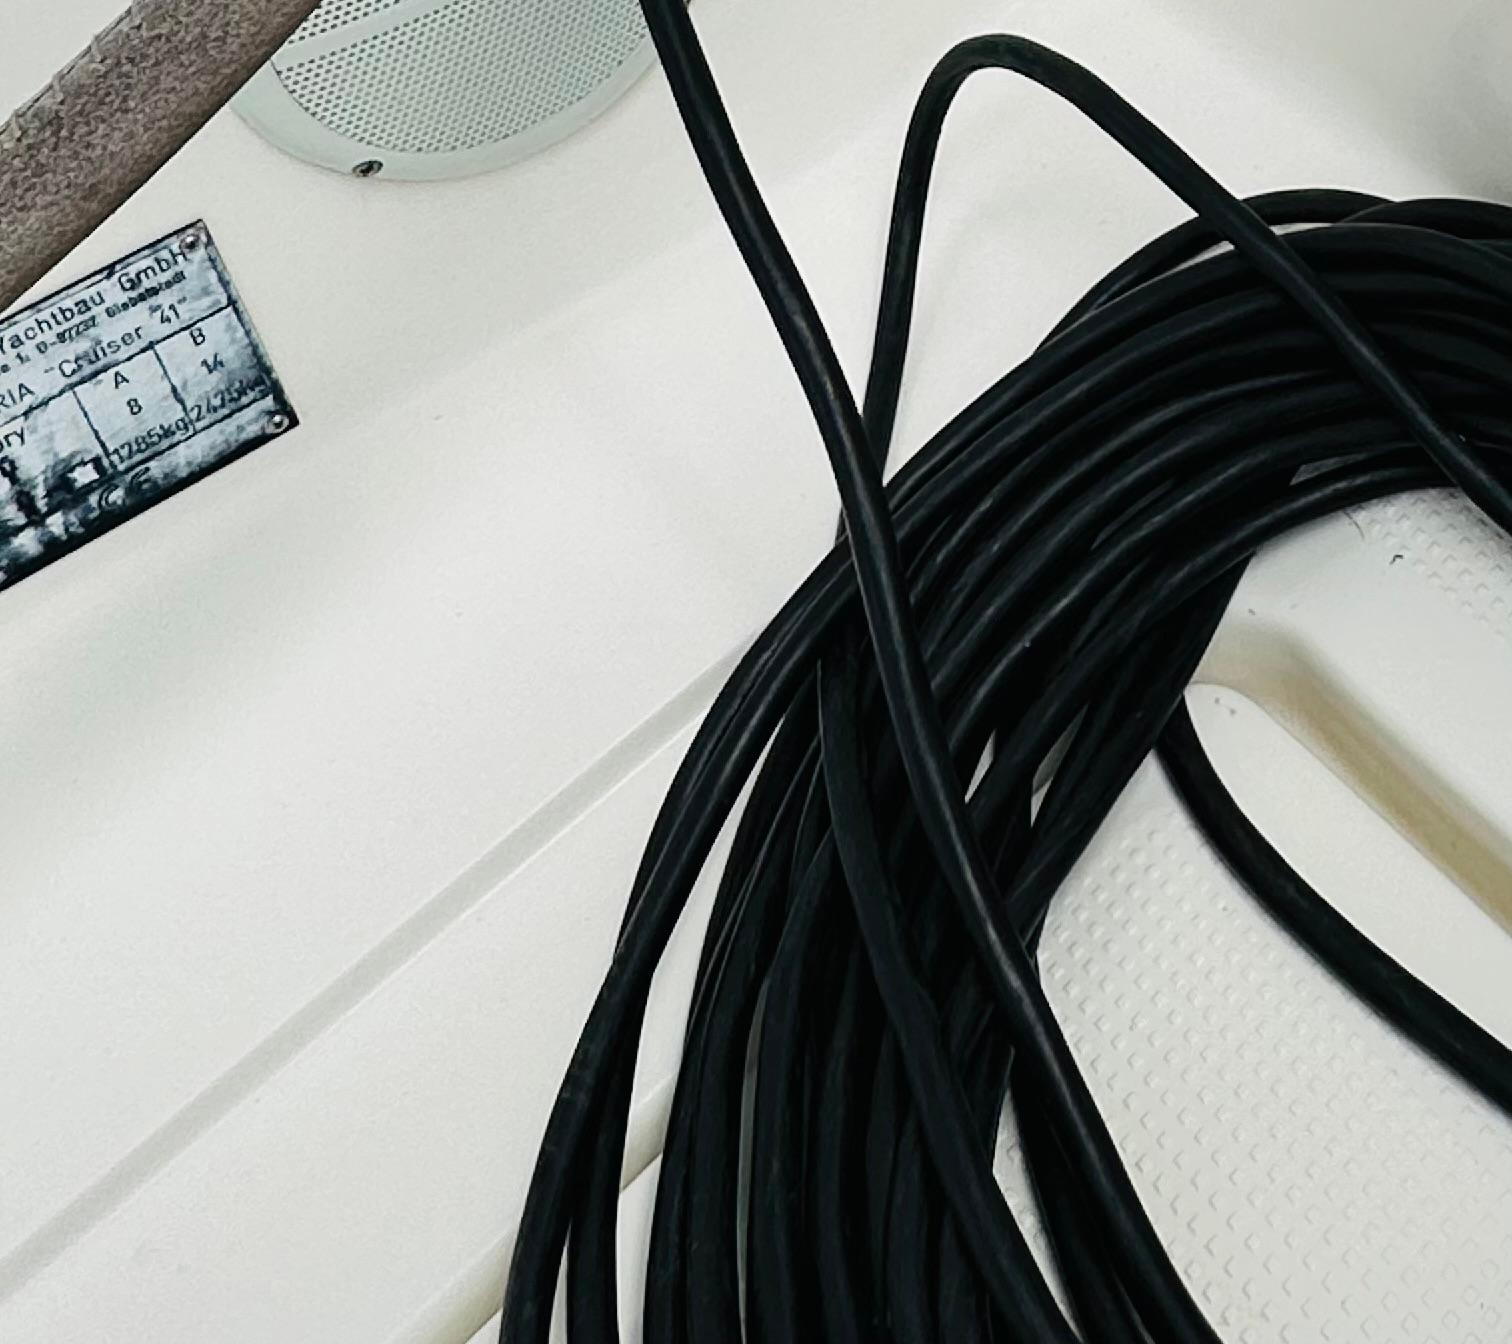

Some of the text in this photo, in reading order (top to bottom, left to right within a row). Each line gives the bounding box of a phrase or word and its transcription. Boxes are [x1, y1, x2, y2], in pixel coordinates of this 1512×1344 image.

[118, 248, 187, 291] GmbH
[114, 370, 129, 389] A
[190, 327, 205, 346] B
[127, 399, 143, 415] 8
